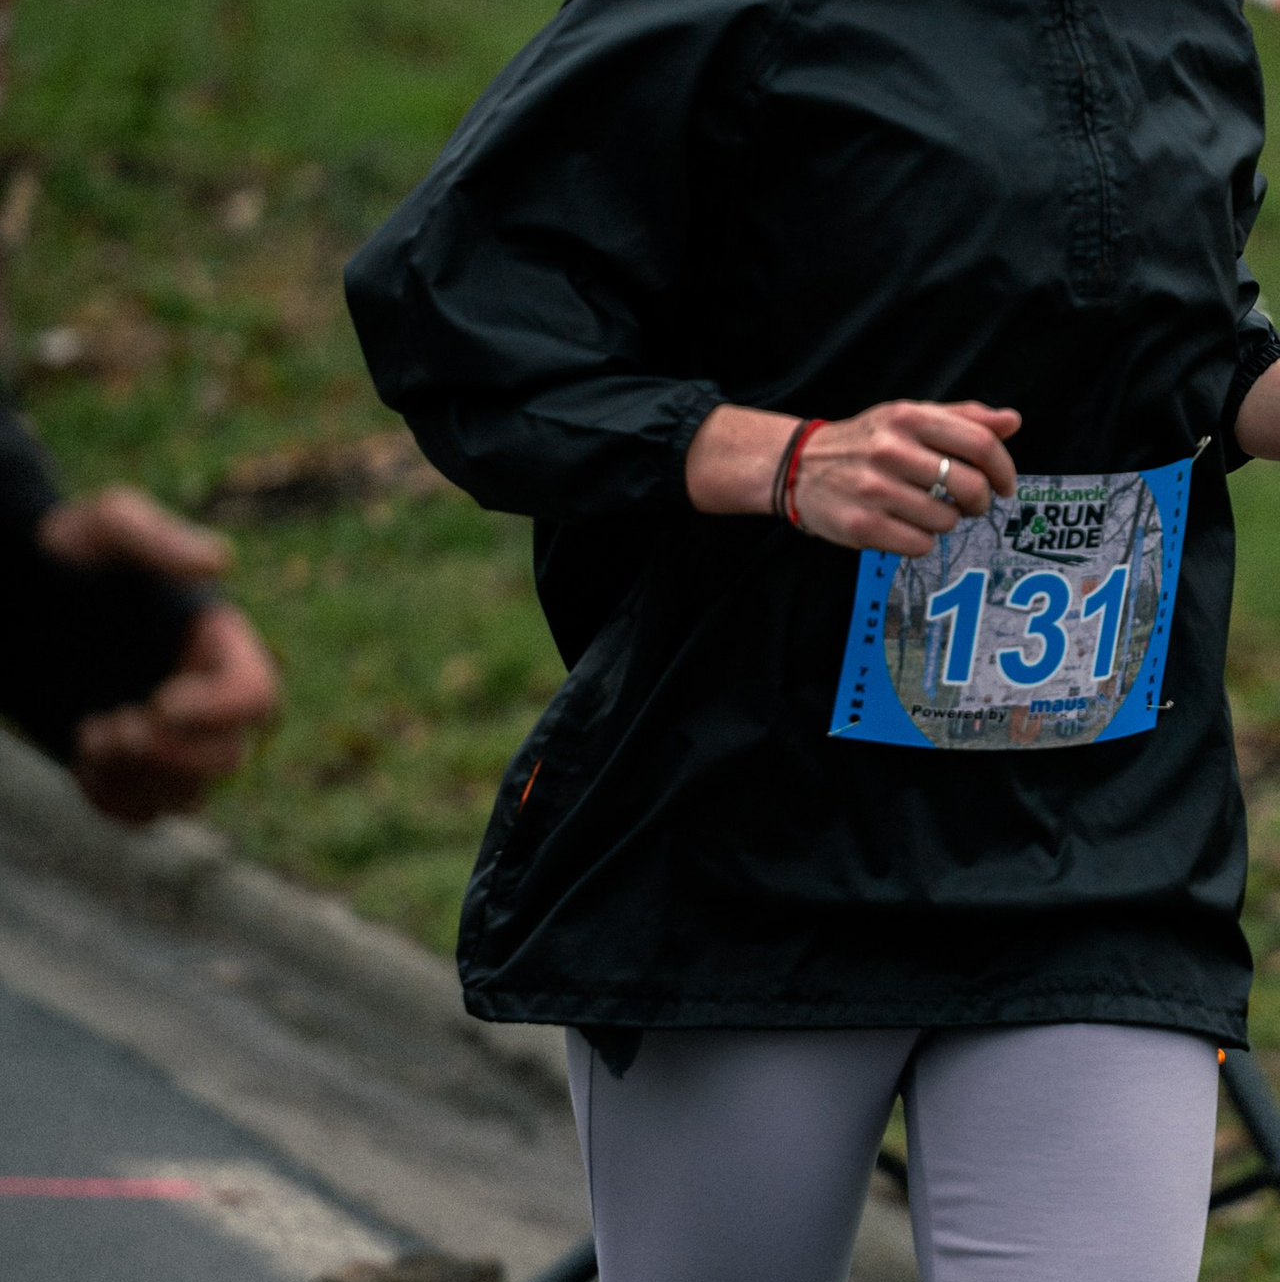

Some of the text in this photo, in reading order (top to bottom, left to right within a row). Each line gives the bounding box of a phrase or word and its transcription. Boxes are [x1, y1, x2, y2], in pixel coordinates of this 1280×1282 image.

[1031, 515, 1047, 534] &
[1044, 503, 1107, 527] RUN
[1038, 527, 1102, 550] RIDE
[926, 564, 1130, 687] 131
[851, 600, 881, 709] RUN 7KM
[911, 704, 1008, 723] Powered by
[1030, 697, 1088, 714] maus
